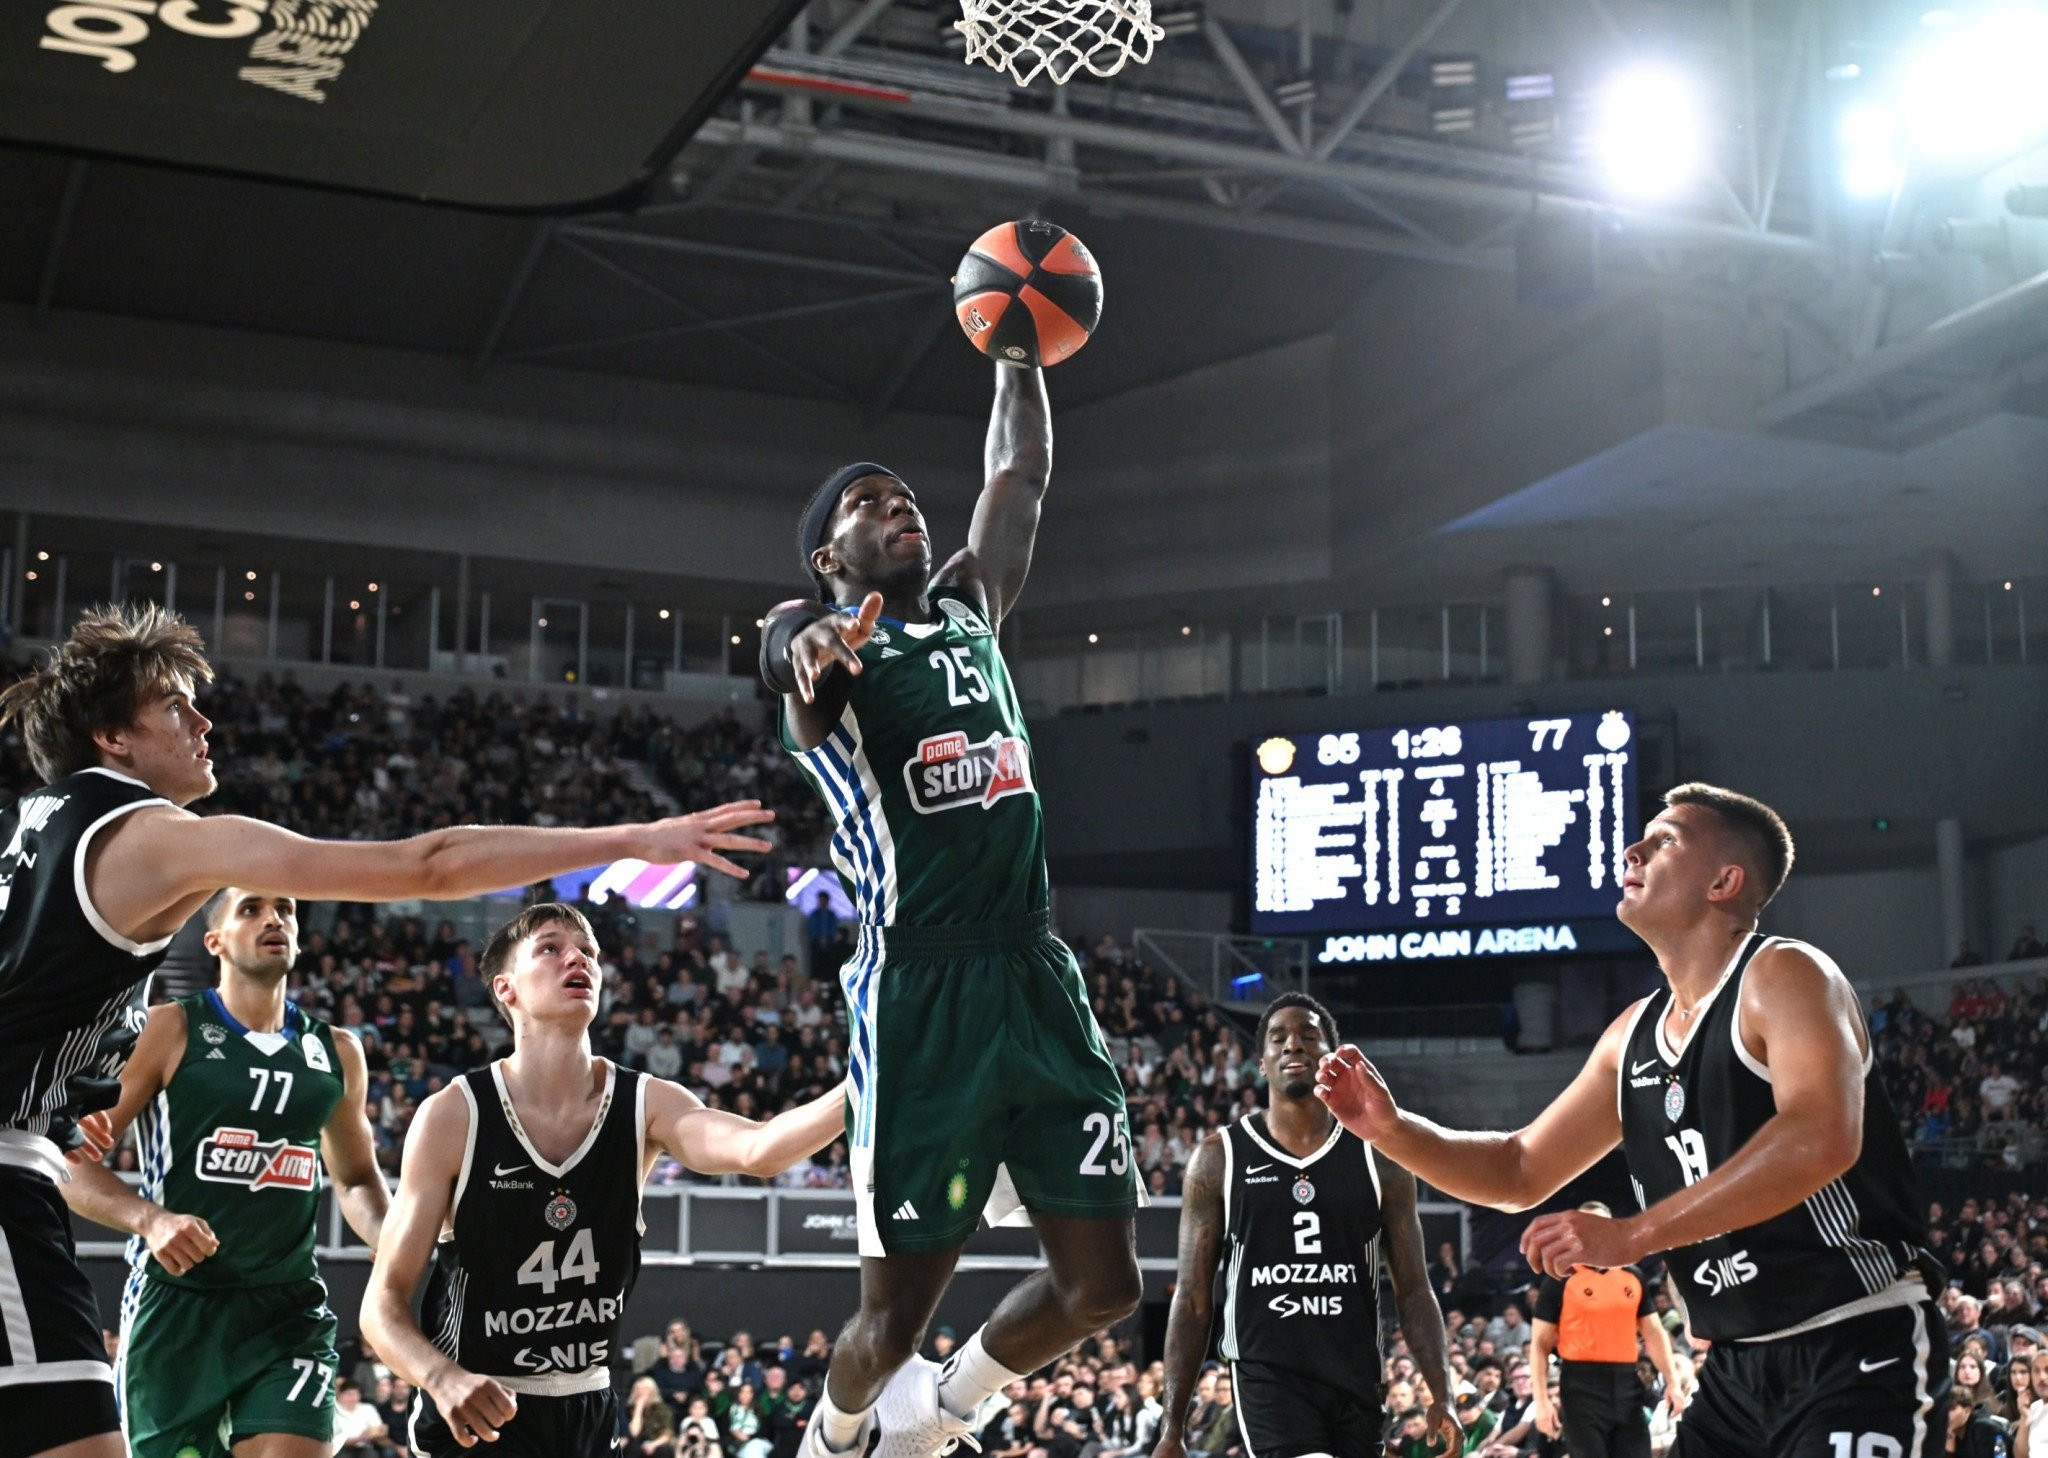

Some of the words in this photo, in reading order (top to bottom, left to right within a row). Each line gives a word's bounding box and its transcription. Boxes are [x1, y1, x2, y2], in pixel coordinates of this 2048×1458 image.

[928, 646, 990, 707] 25
[926, 739, 963, 762] pame
[1317, 733, 1361, 766] 85
[1528, 719, 1571, 752] 77
[1318, 934, 1397, 963] JOHN
[1400, 930, 1471, 958] CAIN
[1474, 924, 1577, 955] ARENA
[249, 1067, 294, 1115] 77
[220, 1132, 251, 1147] pame
[1080, 1112, 1128, 1176] 25
[1664, 1128, 1709, 1188] 19
[496, 1180, 534, 1190] AikBank
[1250, 1174, 1279, 1185] AikBank
[1293, 1211, 1322, 1254] 2
[516, 1227, 600, 1295] 44
[1251, 1263, 1357, 1287] MOZZART
[1717, 1249, 1759, 1288] NIS
[484, 1287, 625, 1338] MOZZART
[1301, 1296, 1343, 1316] NIS
[550, 1339, 609, 1369] NIS
[286, 1357, 333, 1408] 77
